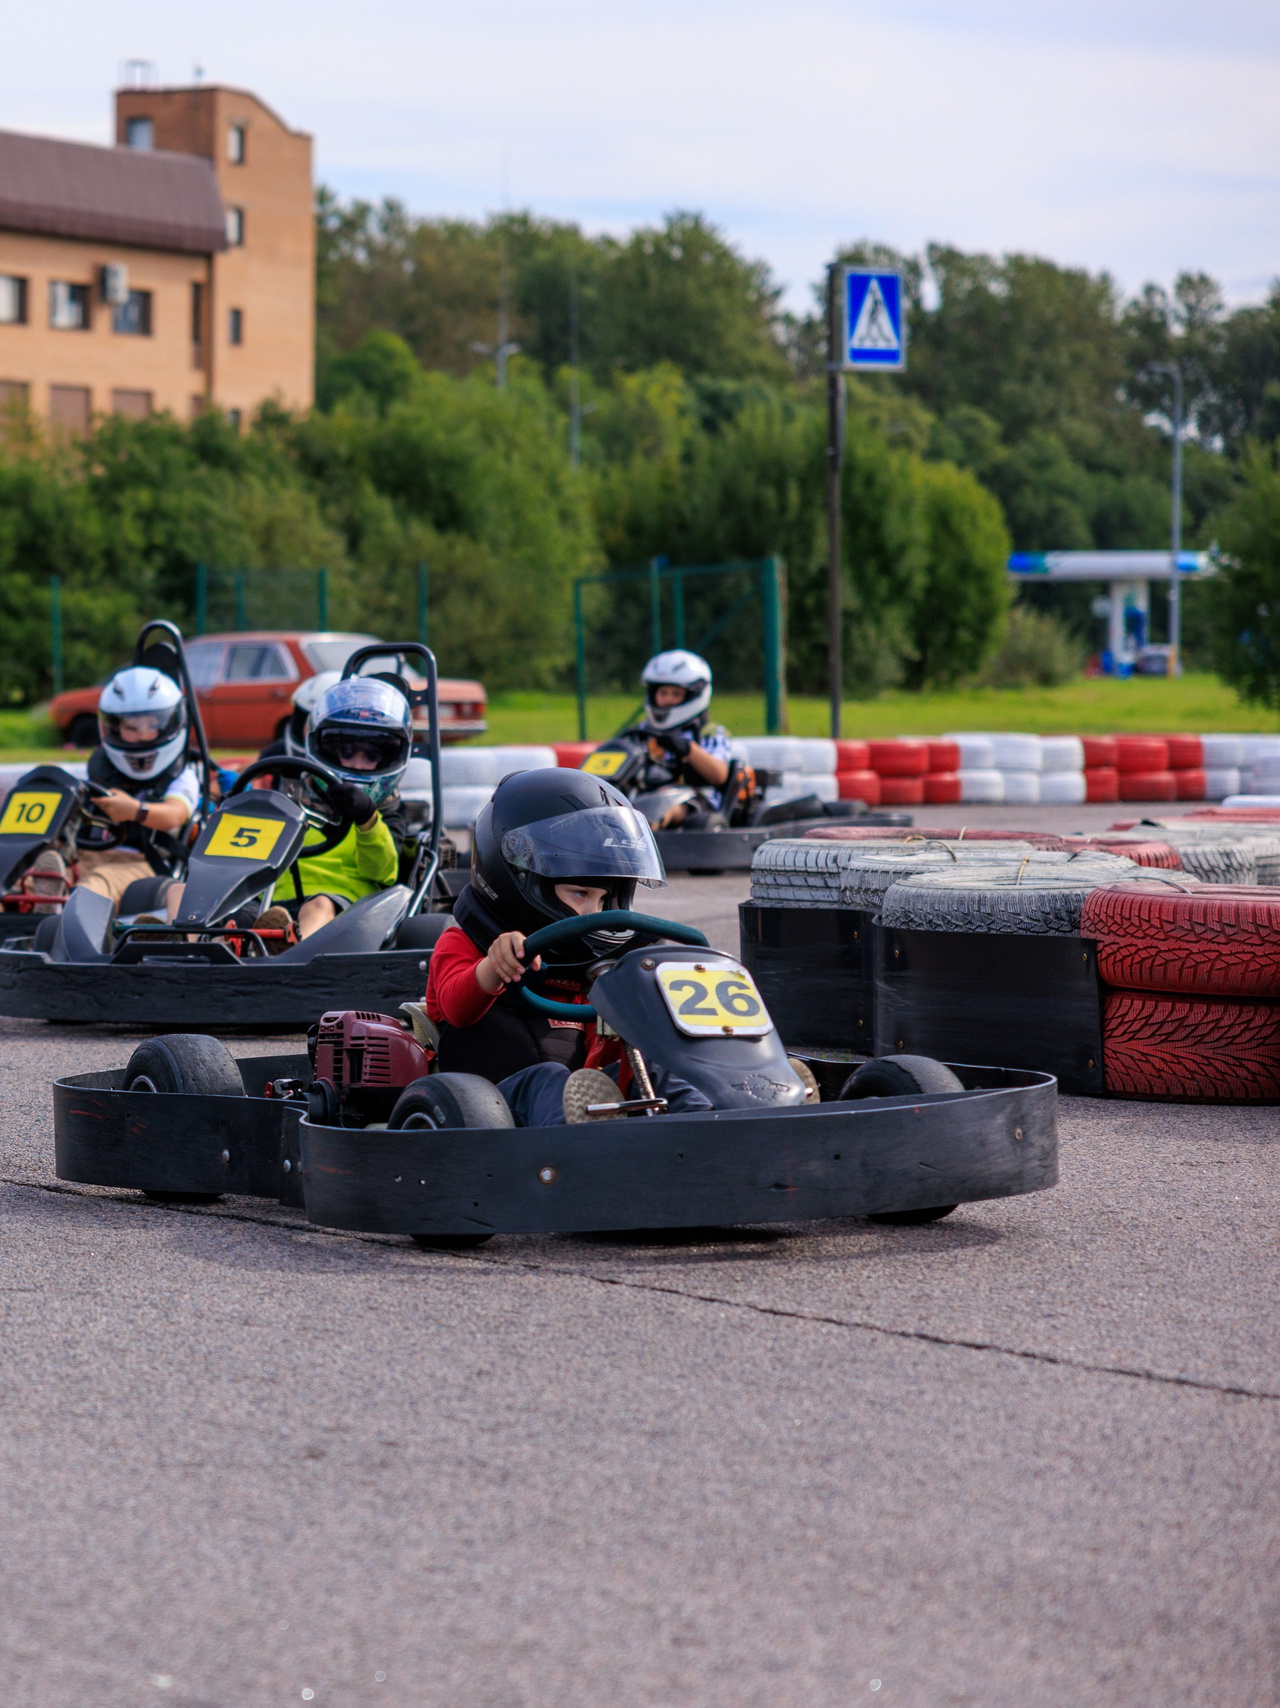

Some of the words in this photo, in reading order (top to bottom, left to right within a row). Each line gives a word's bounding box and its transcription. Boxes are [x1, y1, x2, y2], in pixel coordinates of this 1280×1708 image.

[15, 803, 46, 824] 10
[229, 827, 262, 848] 5
[602, 837, 647, 853] LS2
[668, 979, 760, 1017] 26
